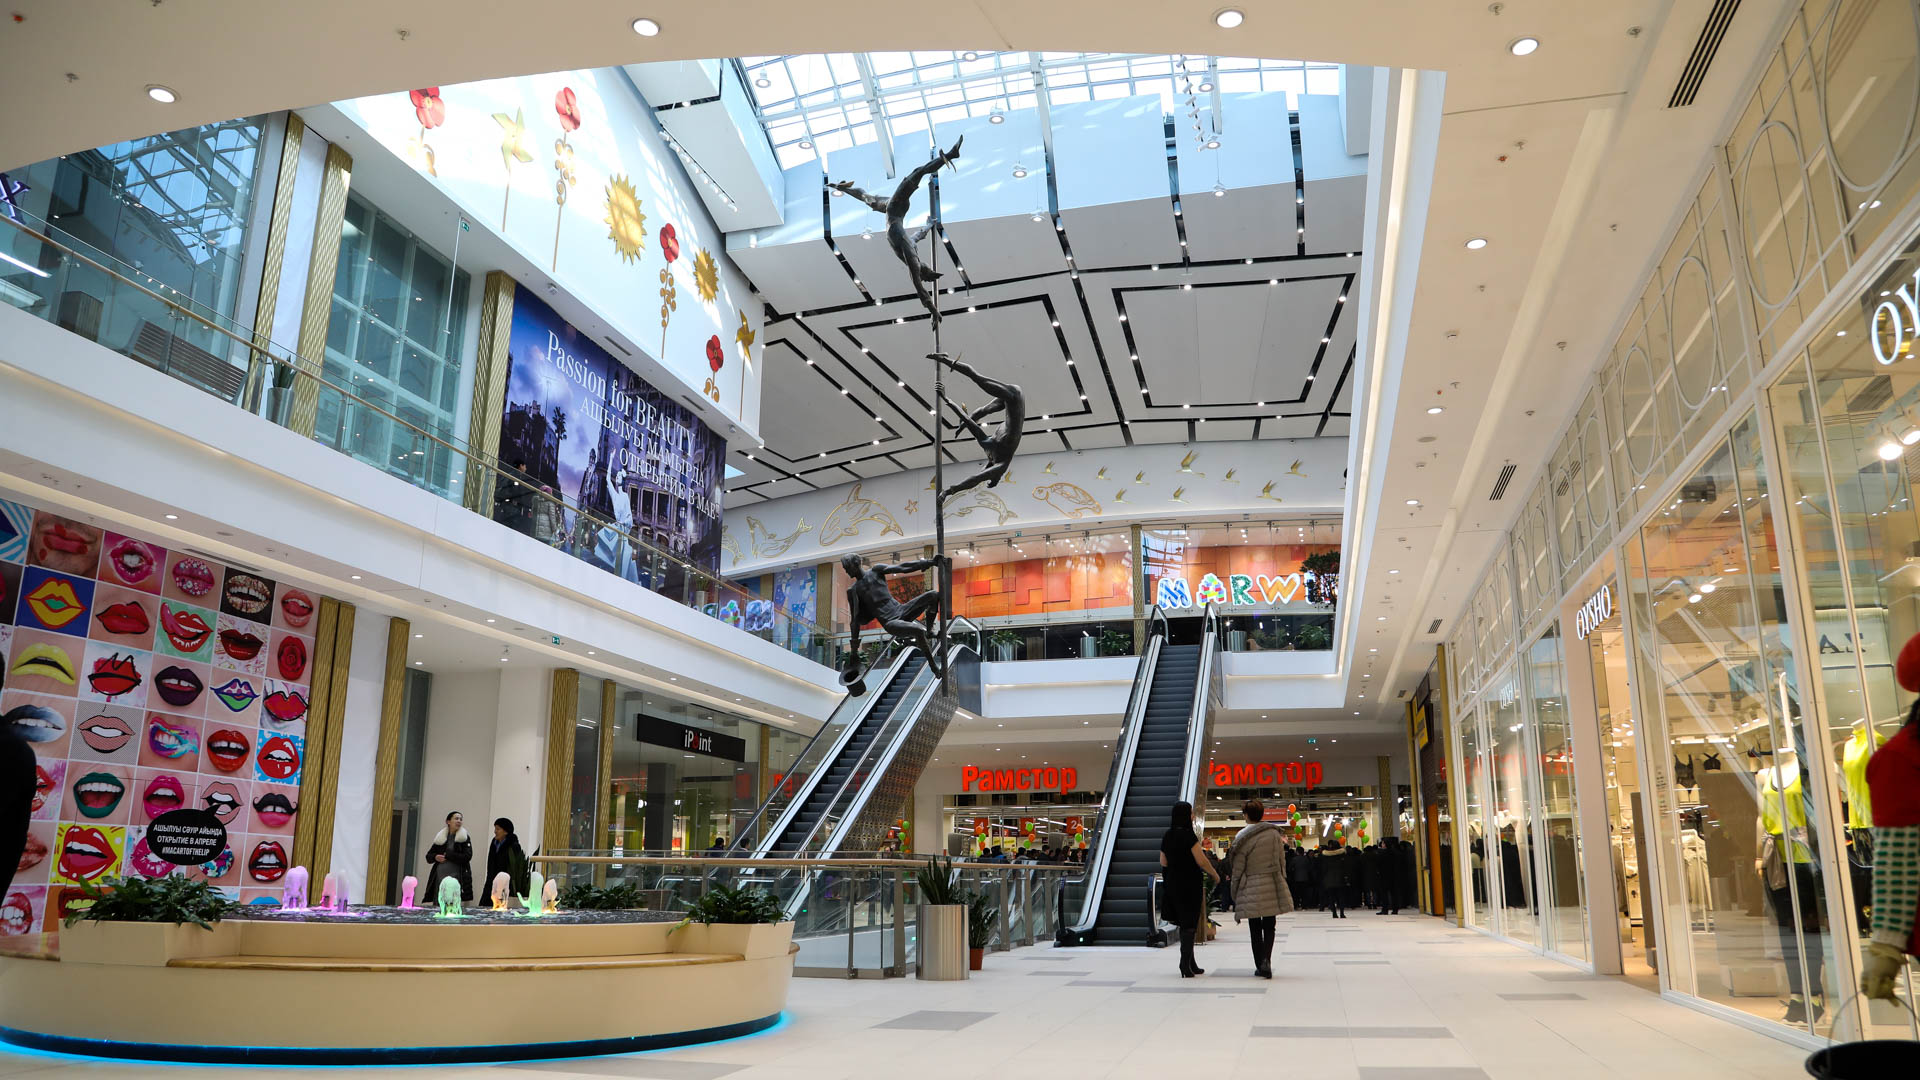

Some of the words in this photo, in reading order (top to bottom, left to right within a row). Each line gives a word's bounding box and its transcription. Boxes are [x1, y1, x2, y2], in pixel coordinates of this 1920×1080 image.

[546, 330, 607, 401] Passion
[611, 379, 632, 416] for
[636, 396, 696, 458] BEAUTY
[580, 397, 645, 451] АШЫЛУЫ
[647, 438, 705, 488] МАМЫРДА
[619, 448, 686, 500] ОТКРЫТИЕ
[688, 487, 695, 505] В
[1576, 585, 1611, 641] OYSHO
[684, 729, 712, 752] iPoint
[962, 766, 1078, 795] Рамстор
[153, 824, 181, 833] АШЫЛУЫ
[199, 827, 222, 837] АЙЫНДА
[157, 835, 188, 845] ОТКРЫТИЕ
[189, 836, 194, 845] В
[194, 838, 216, 846] АПРЕЛЕ
[162, 846, 210, 856] #MACARTOFTHELIP
